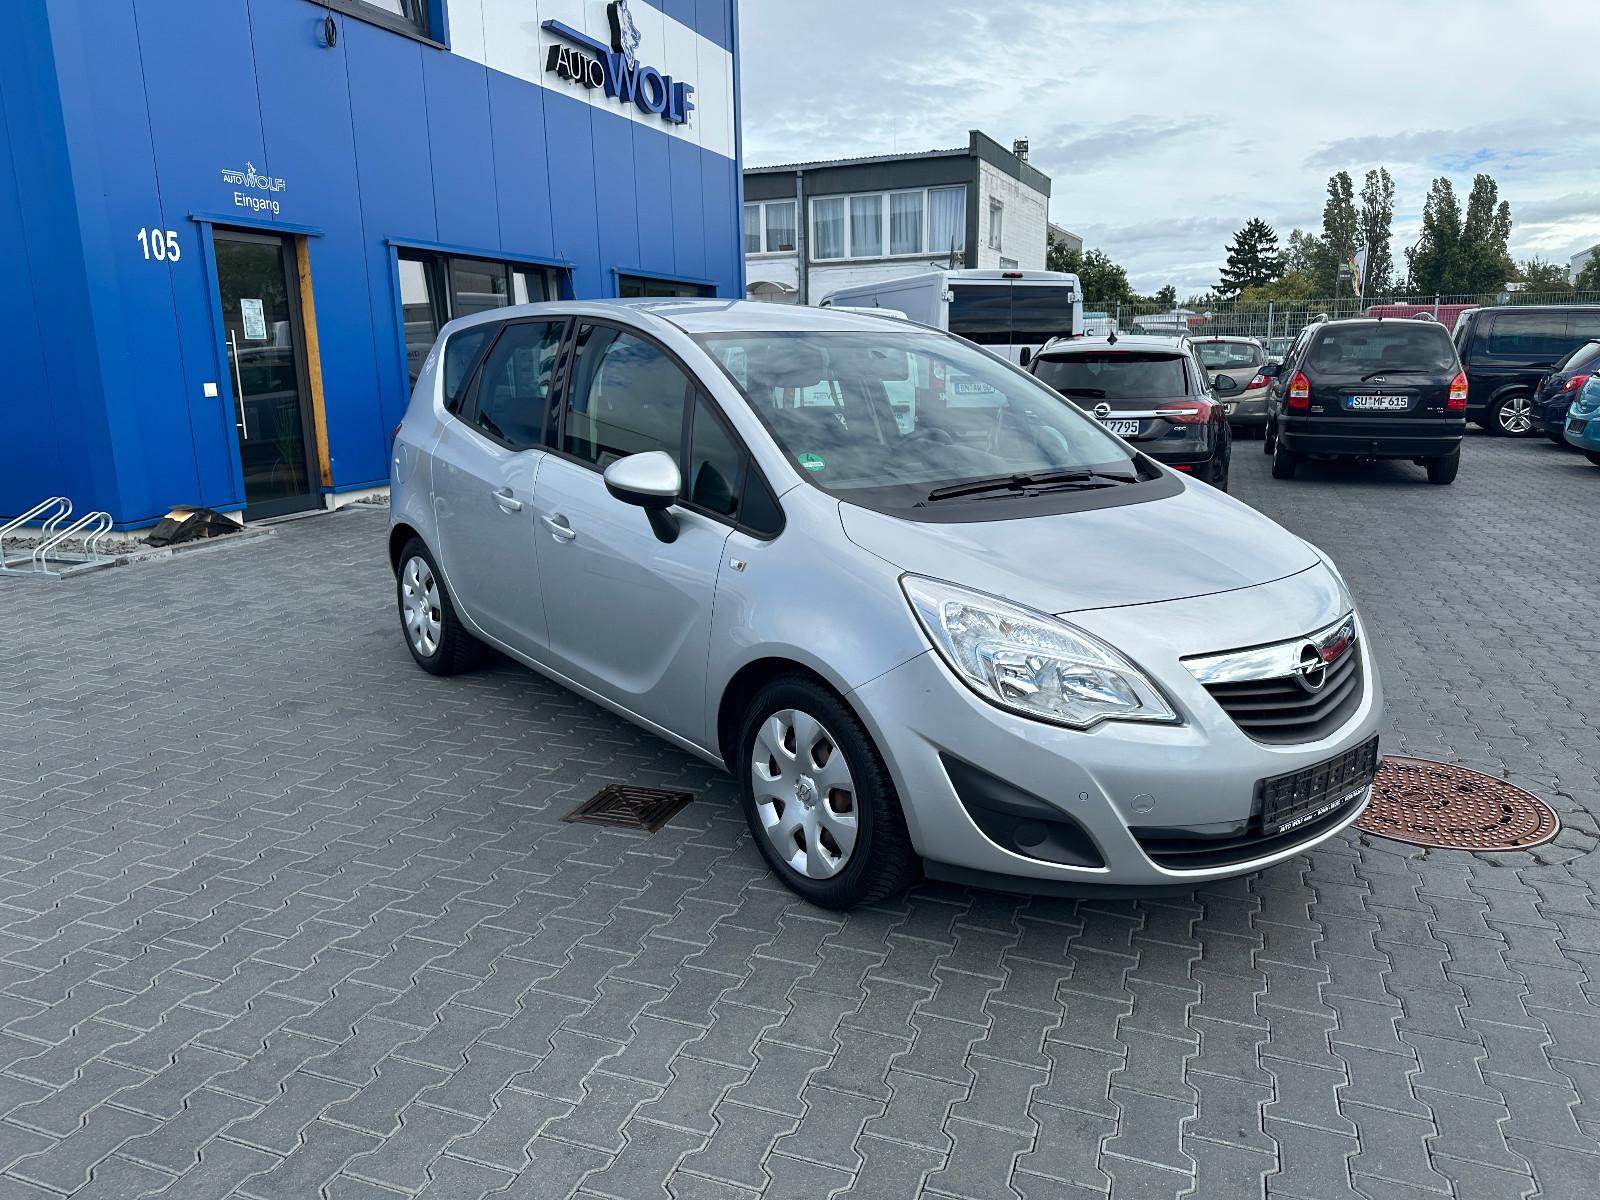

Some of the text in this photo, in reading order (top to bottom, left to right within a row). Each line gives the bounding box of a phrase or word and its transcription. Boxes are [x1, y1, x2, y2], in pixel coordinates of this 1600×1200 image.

[546, 44, 605, 89] AUTO
[597, 47, 695, 125] WOLF
[223, 174, 242, 185] AUTO
[242, 173, 283, 192] WOLF
[234, 191, 280, 214] Eingang
[137, 227, 181, 262] 105
[1354, 396, 1407, 407] SU MF 615
[1110, 421, 1138, 433] 7795
